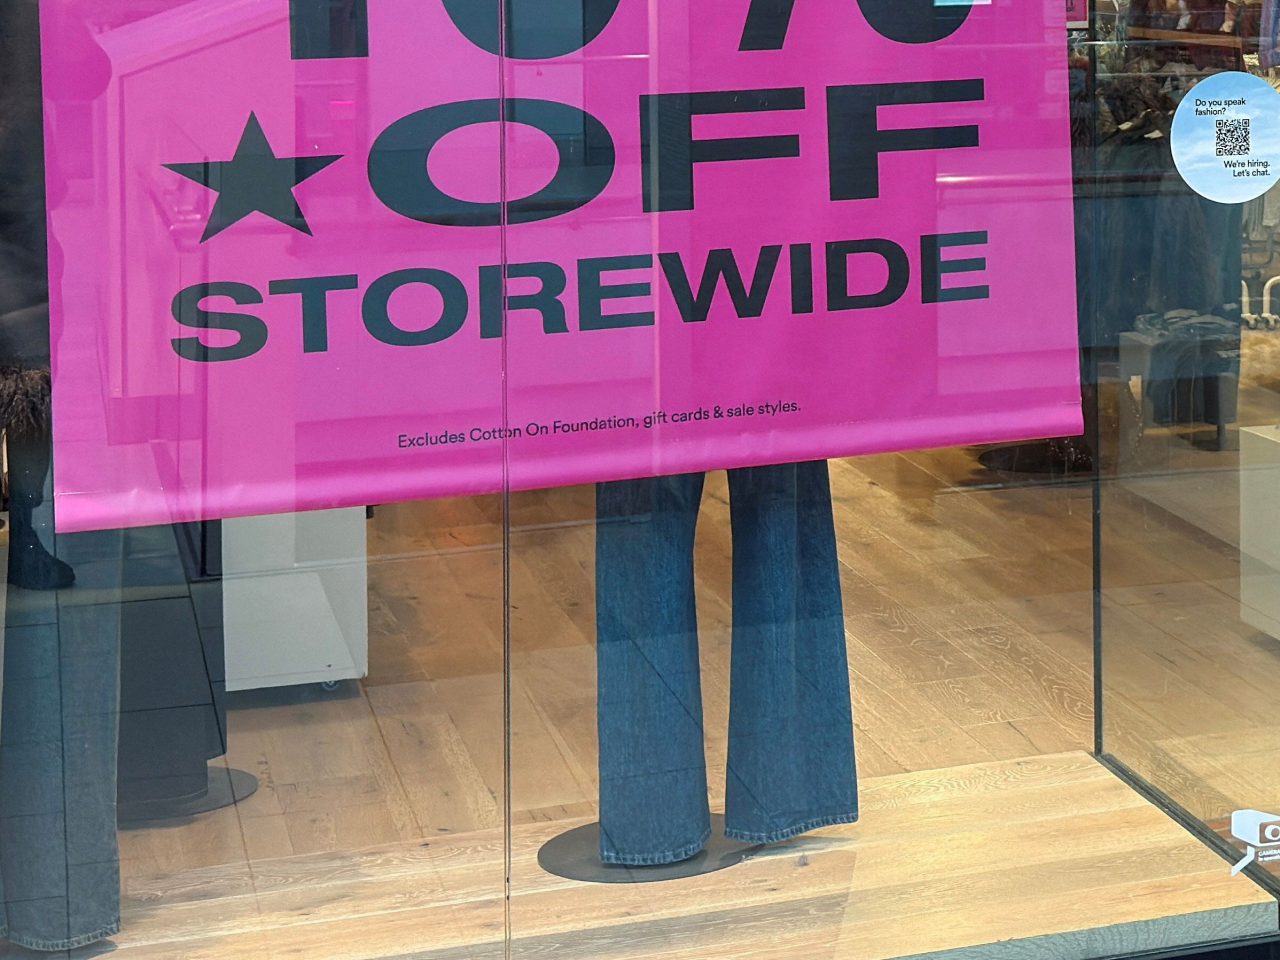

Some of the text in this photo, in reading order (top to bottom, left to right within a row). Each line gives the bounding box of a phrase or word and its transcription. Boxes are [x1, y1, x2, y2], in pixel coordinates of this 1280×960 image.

[1208, 100, 1222, 108] you
[1223, 98, 1246, 107] speak
[1195, 107, 1227, 116] fashion?
[367, 78, 985, 227] OFF
[1224, 159, 1270, 169] We're hiring.
[1233, 169, 1270, 177] Let's chat.
[170, 230, 990, 363] STOREWIDE
[398, 399, 802, 449] Excludes Cotton On Foundation, gift cards & sale styles.
